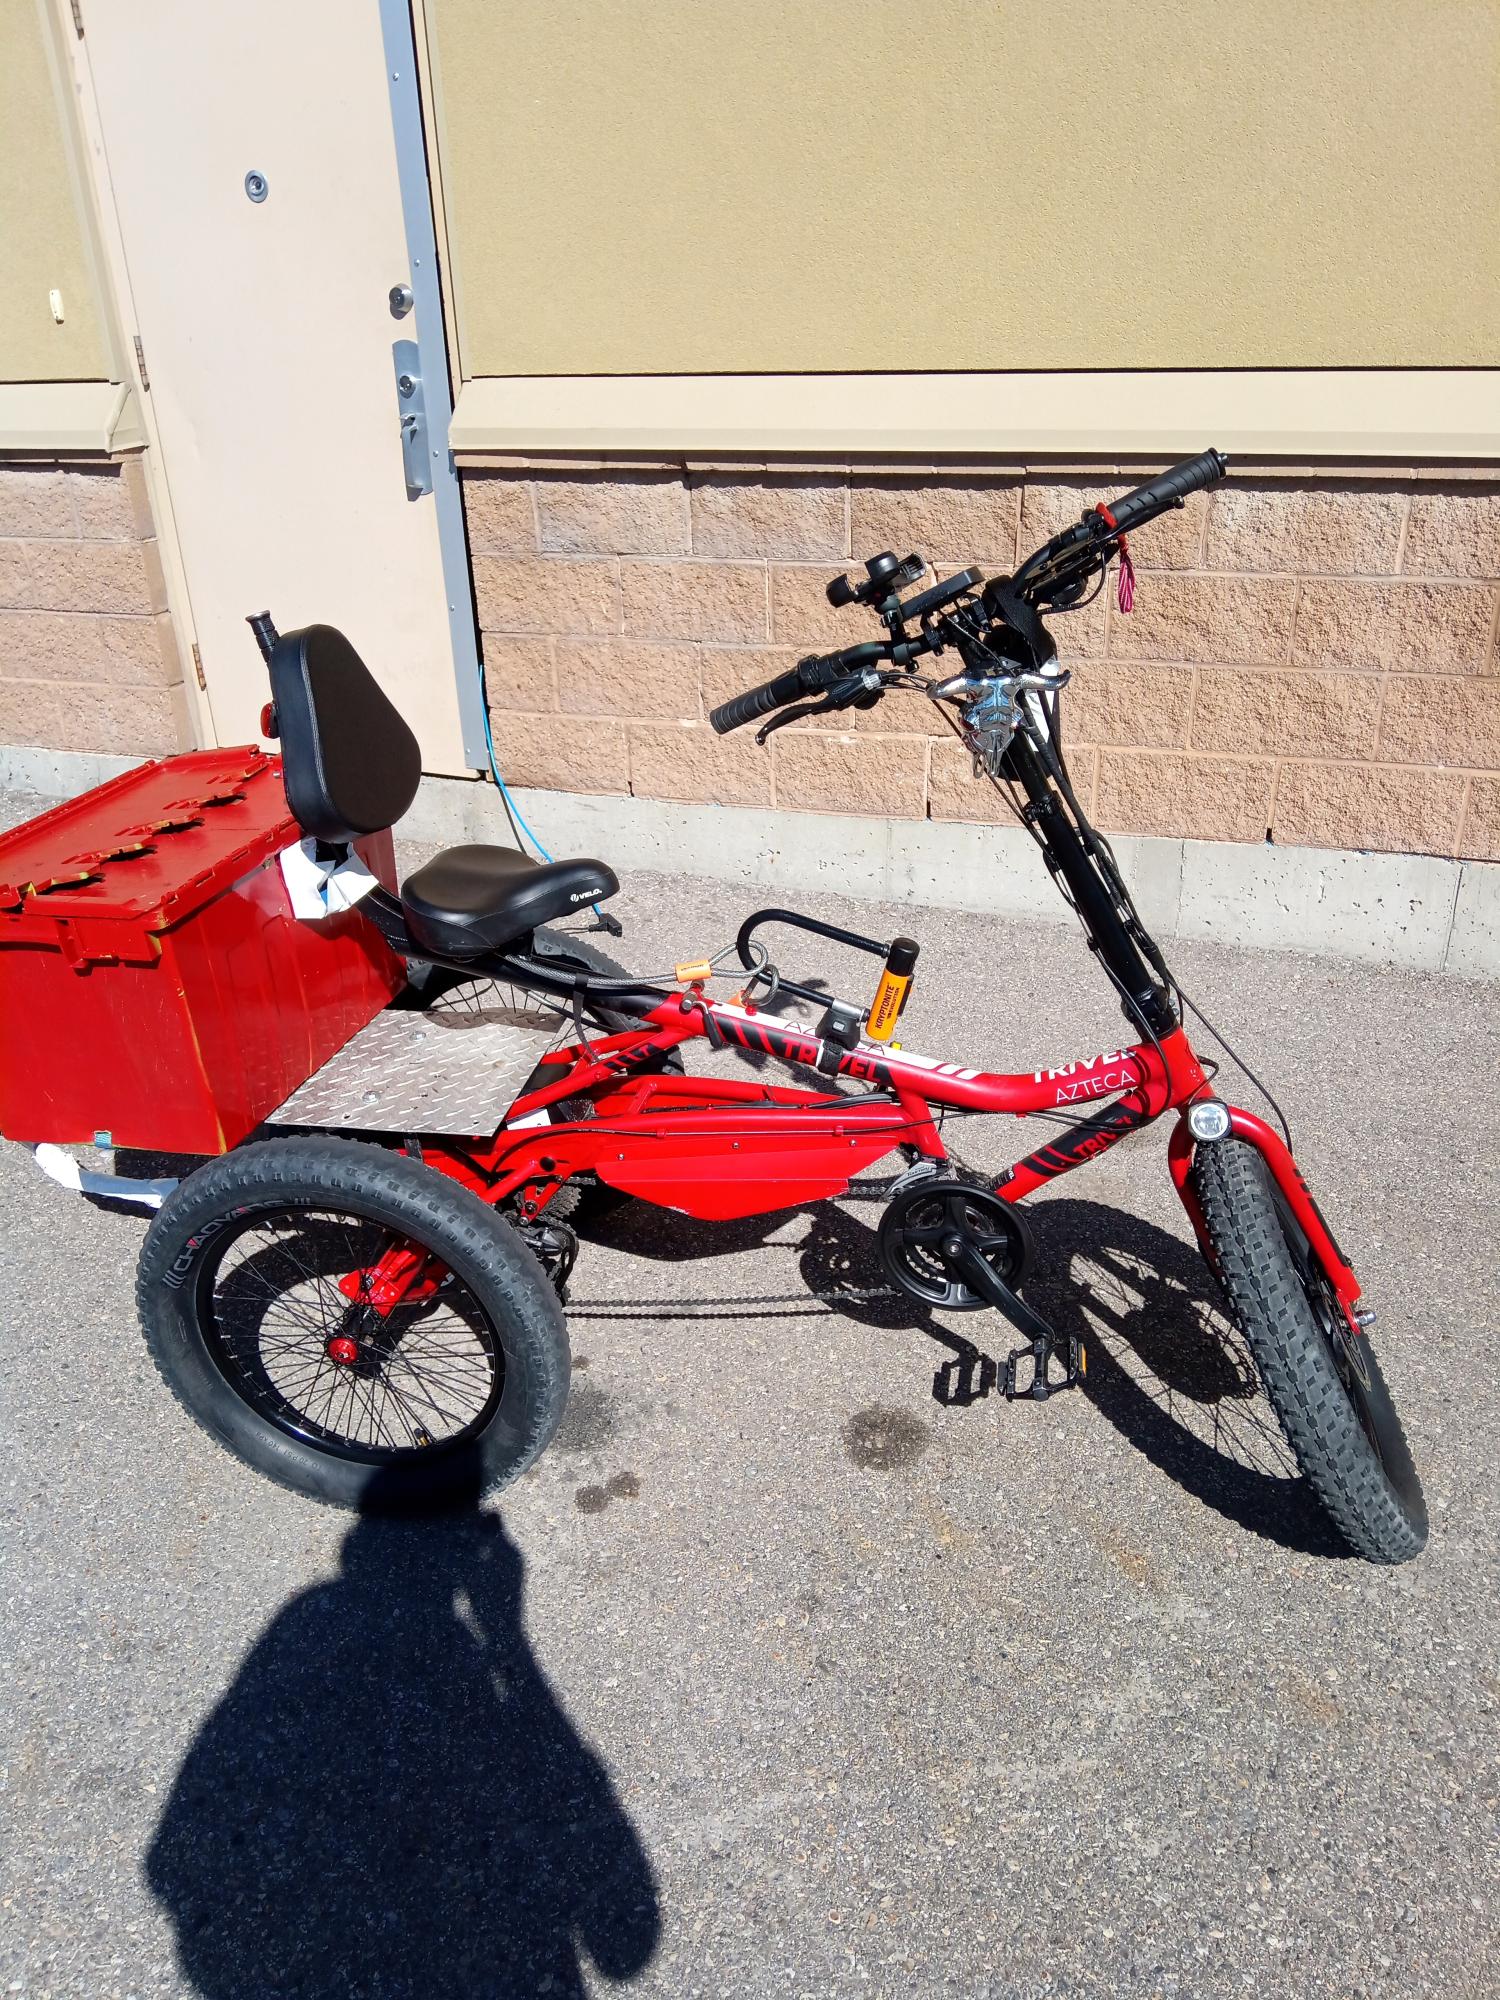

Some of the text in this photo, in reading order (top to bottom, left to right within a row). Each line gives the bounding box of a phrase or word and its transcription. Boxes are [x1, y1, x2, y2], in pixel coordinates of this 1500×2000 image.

[579, 888, 601, 899] VELO
[875, 984, 895, 1029] KRYPTONITE
[1056, 1070, 1137, 1104] AZTECA
